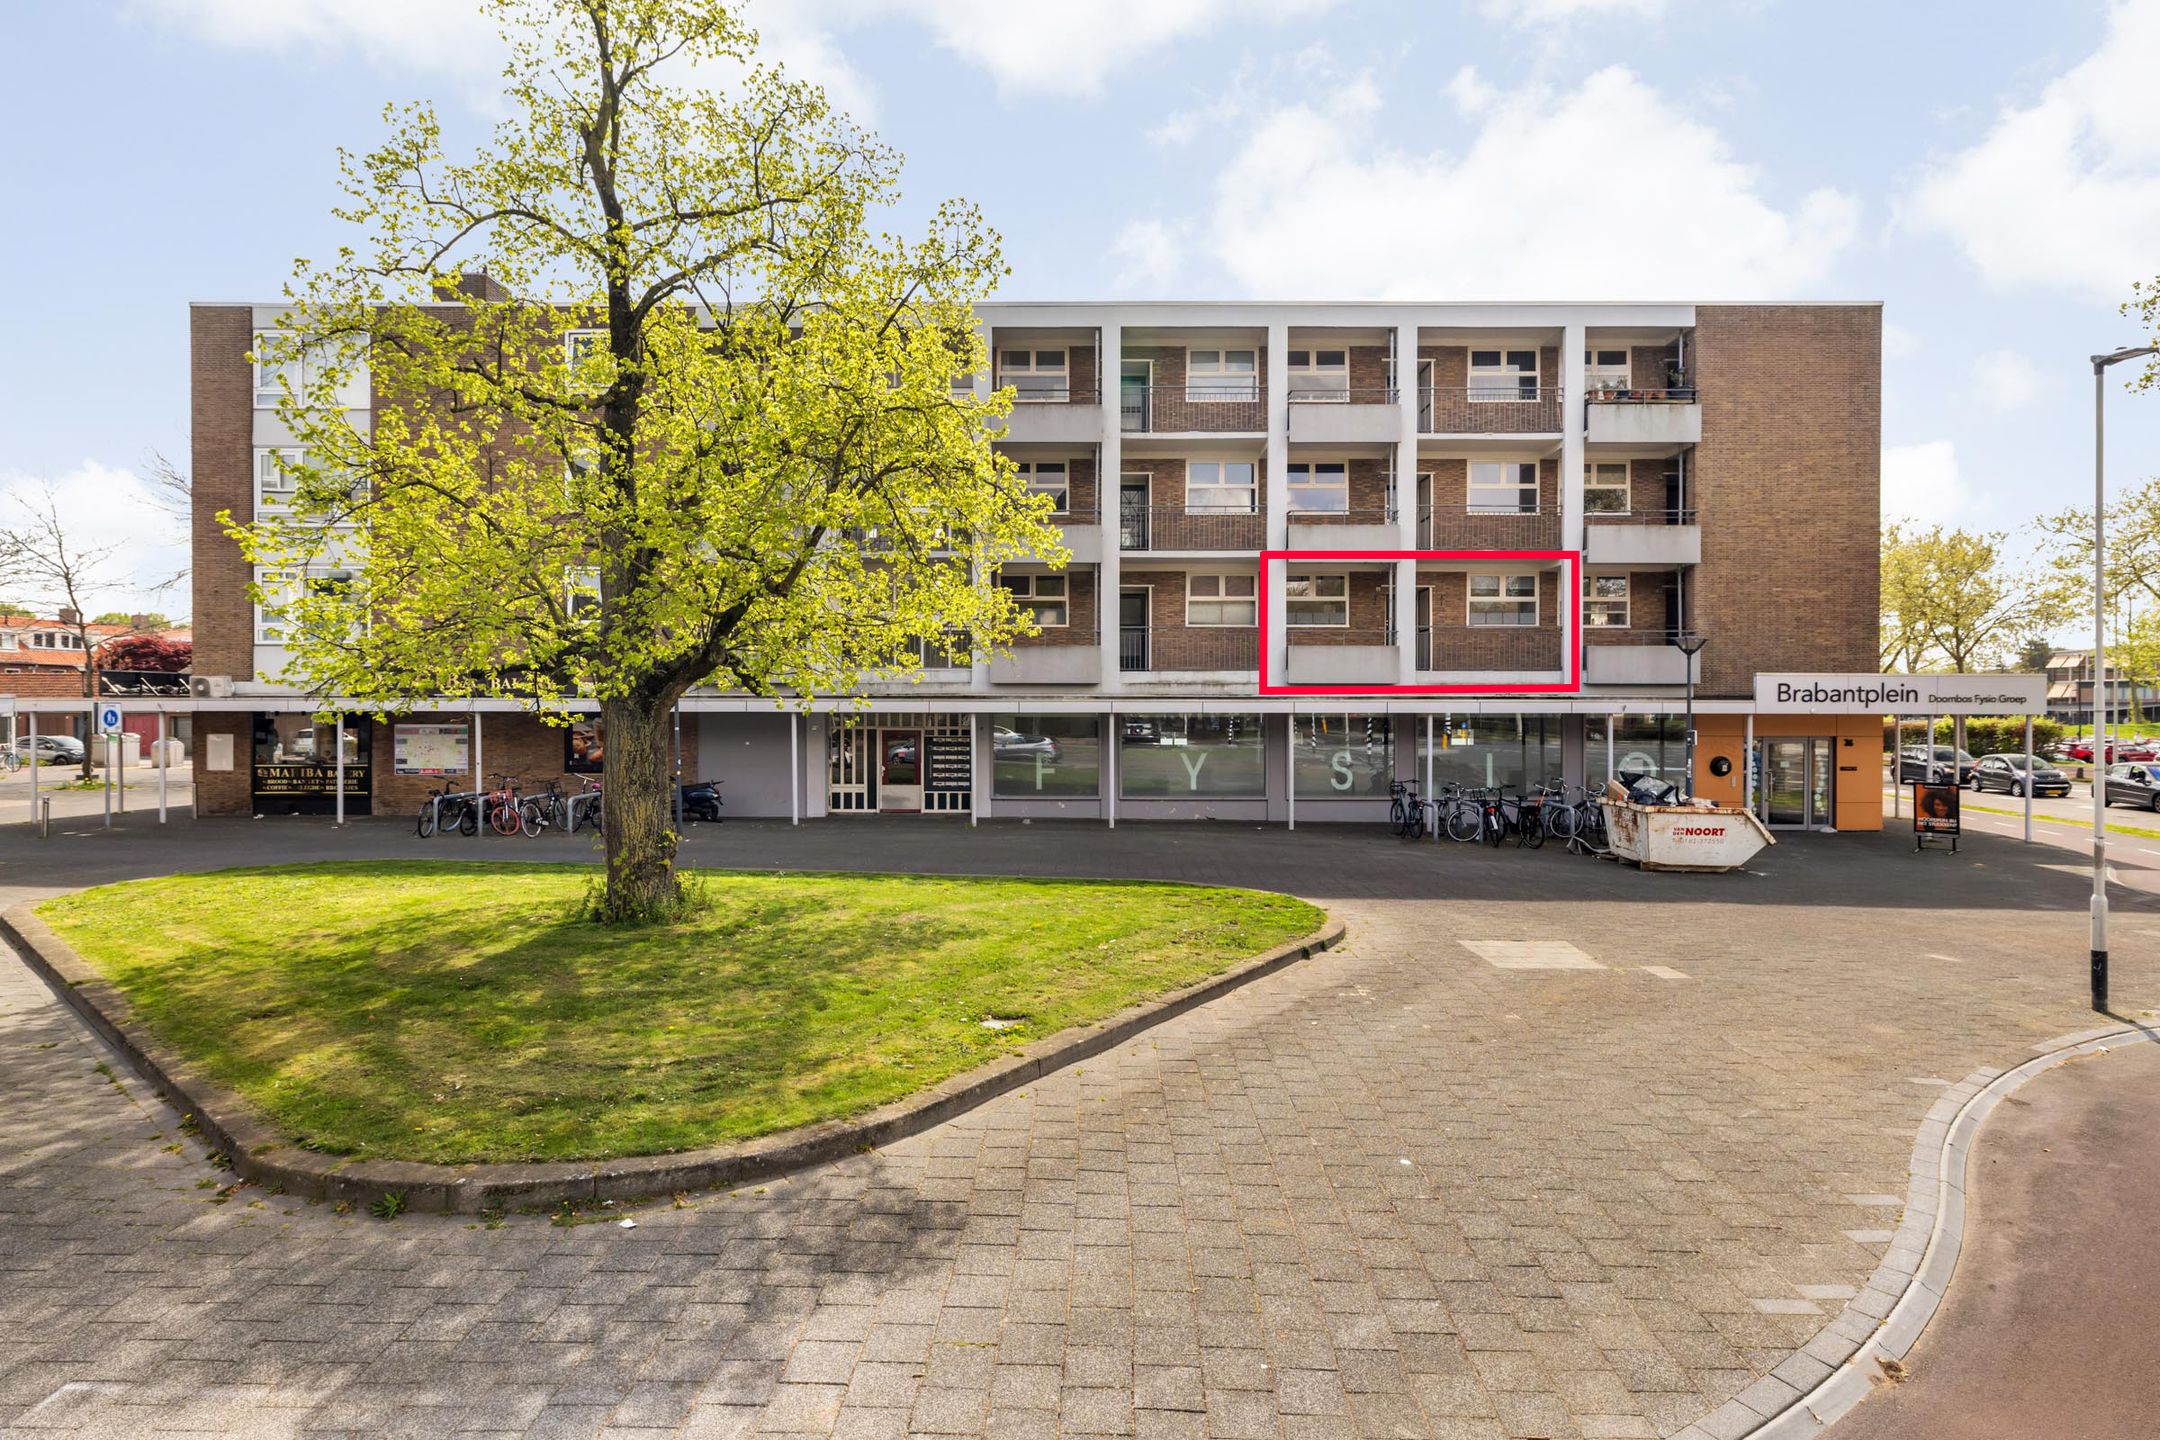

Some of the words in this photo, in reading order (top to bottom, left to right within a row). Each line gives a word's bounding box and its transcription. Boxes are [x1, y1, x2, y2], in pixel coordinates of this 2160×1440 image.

[1777, 682, 1919, 708] Brabantplein
[1974, 694, 1997, 705] Fysio
[1998, 694, 2027, 704] Groep
[1685, 827, 1725, 836] NOORT
